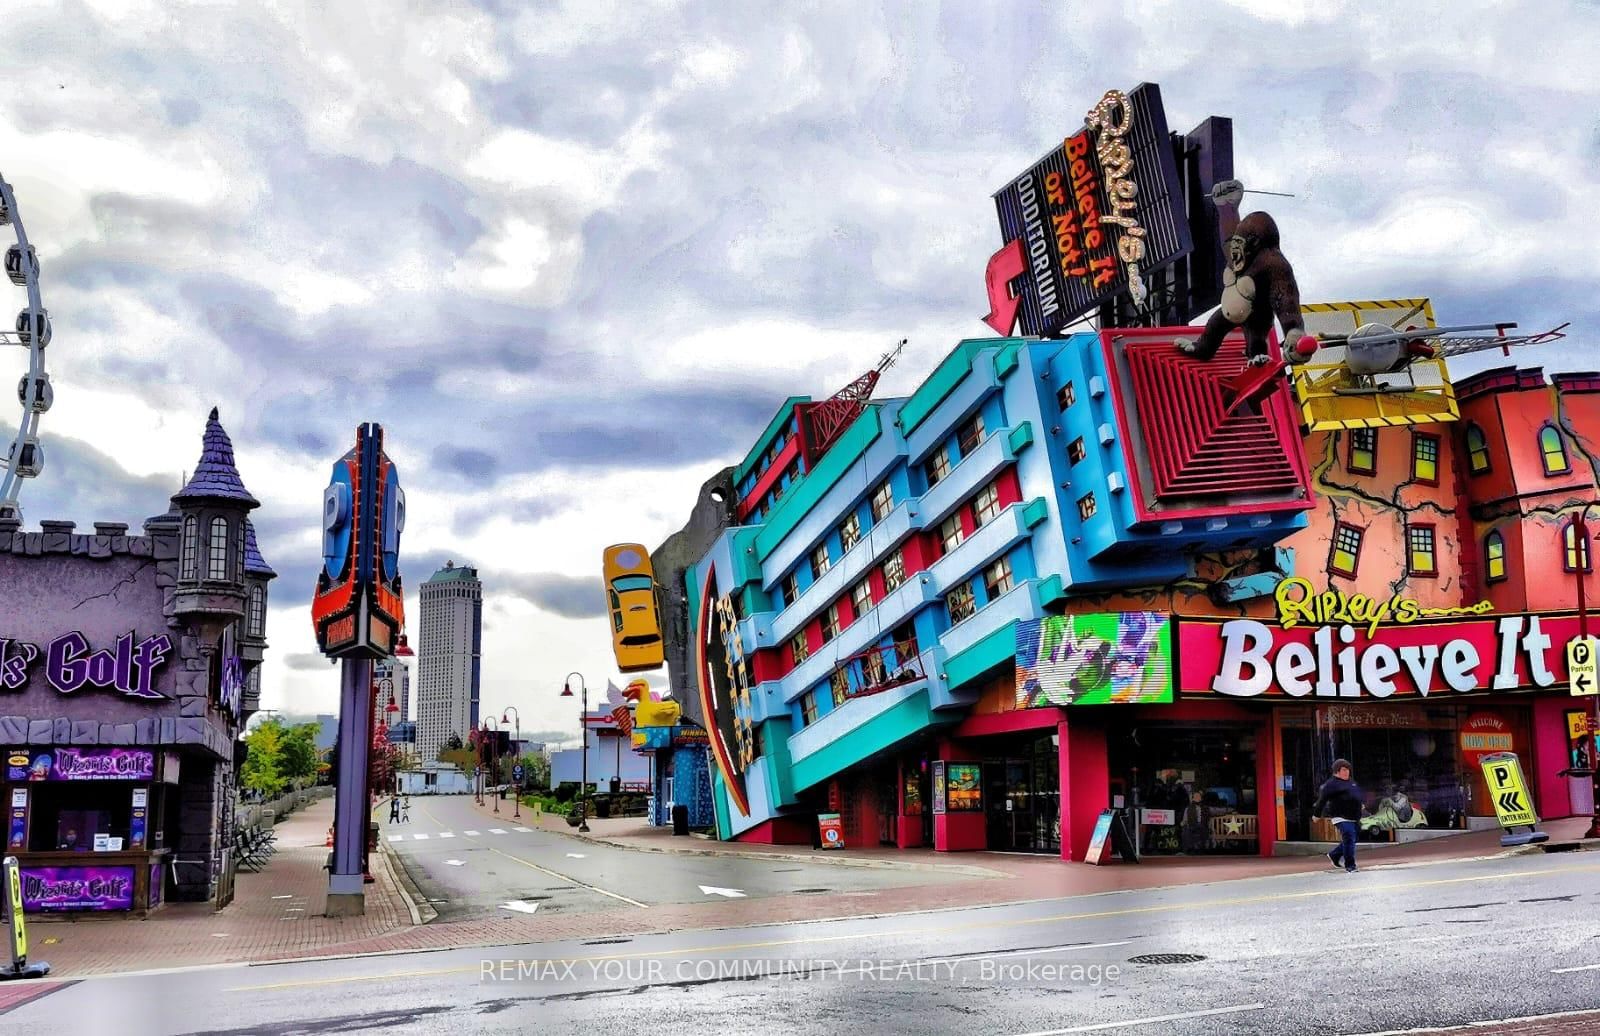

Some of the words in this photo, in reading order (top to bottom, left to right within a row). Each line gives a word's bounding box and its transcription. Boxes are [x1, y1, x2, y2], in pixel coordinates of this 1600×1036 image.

[1044, 171, 1067, 205] or
[1064, 130, 1104, 250] Believe
[1089, 255, 1118, 289] It
[1017, 174, 1060, 317] ODDITORIUM
[1053, 211, 1089, 282] Not!
[46, 631, 172, 699] Golf
[1212, 619, 1481, 698] Believe
[1493, 615, 1556, 690] It
[1570, 665, 1594, 673] Parking
[1470, 718, 1504, 730] WELCOME
[116, 751, 154, 775] Golf
[1494, 767, 1508, 787] P
[1500, 814, 1516, 823] ENTER
[1517, 812, 1531, 820] HERE
[88, 875, 128, 900] Golf
